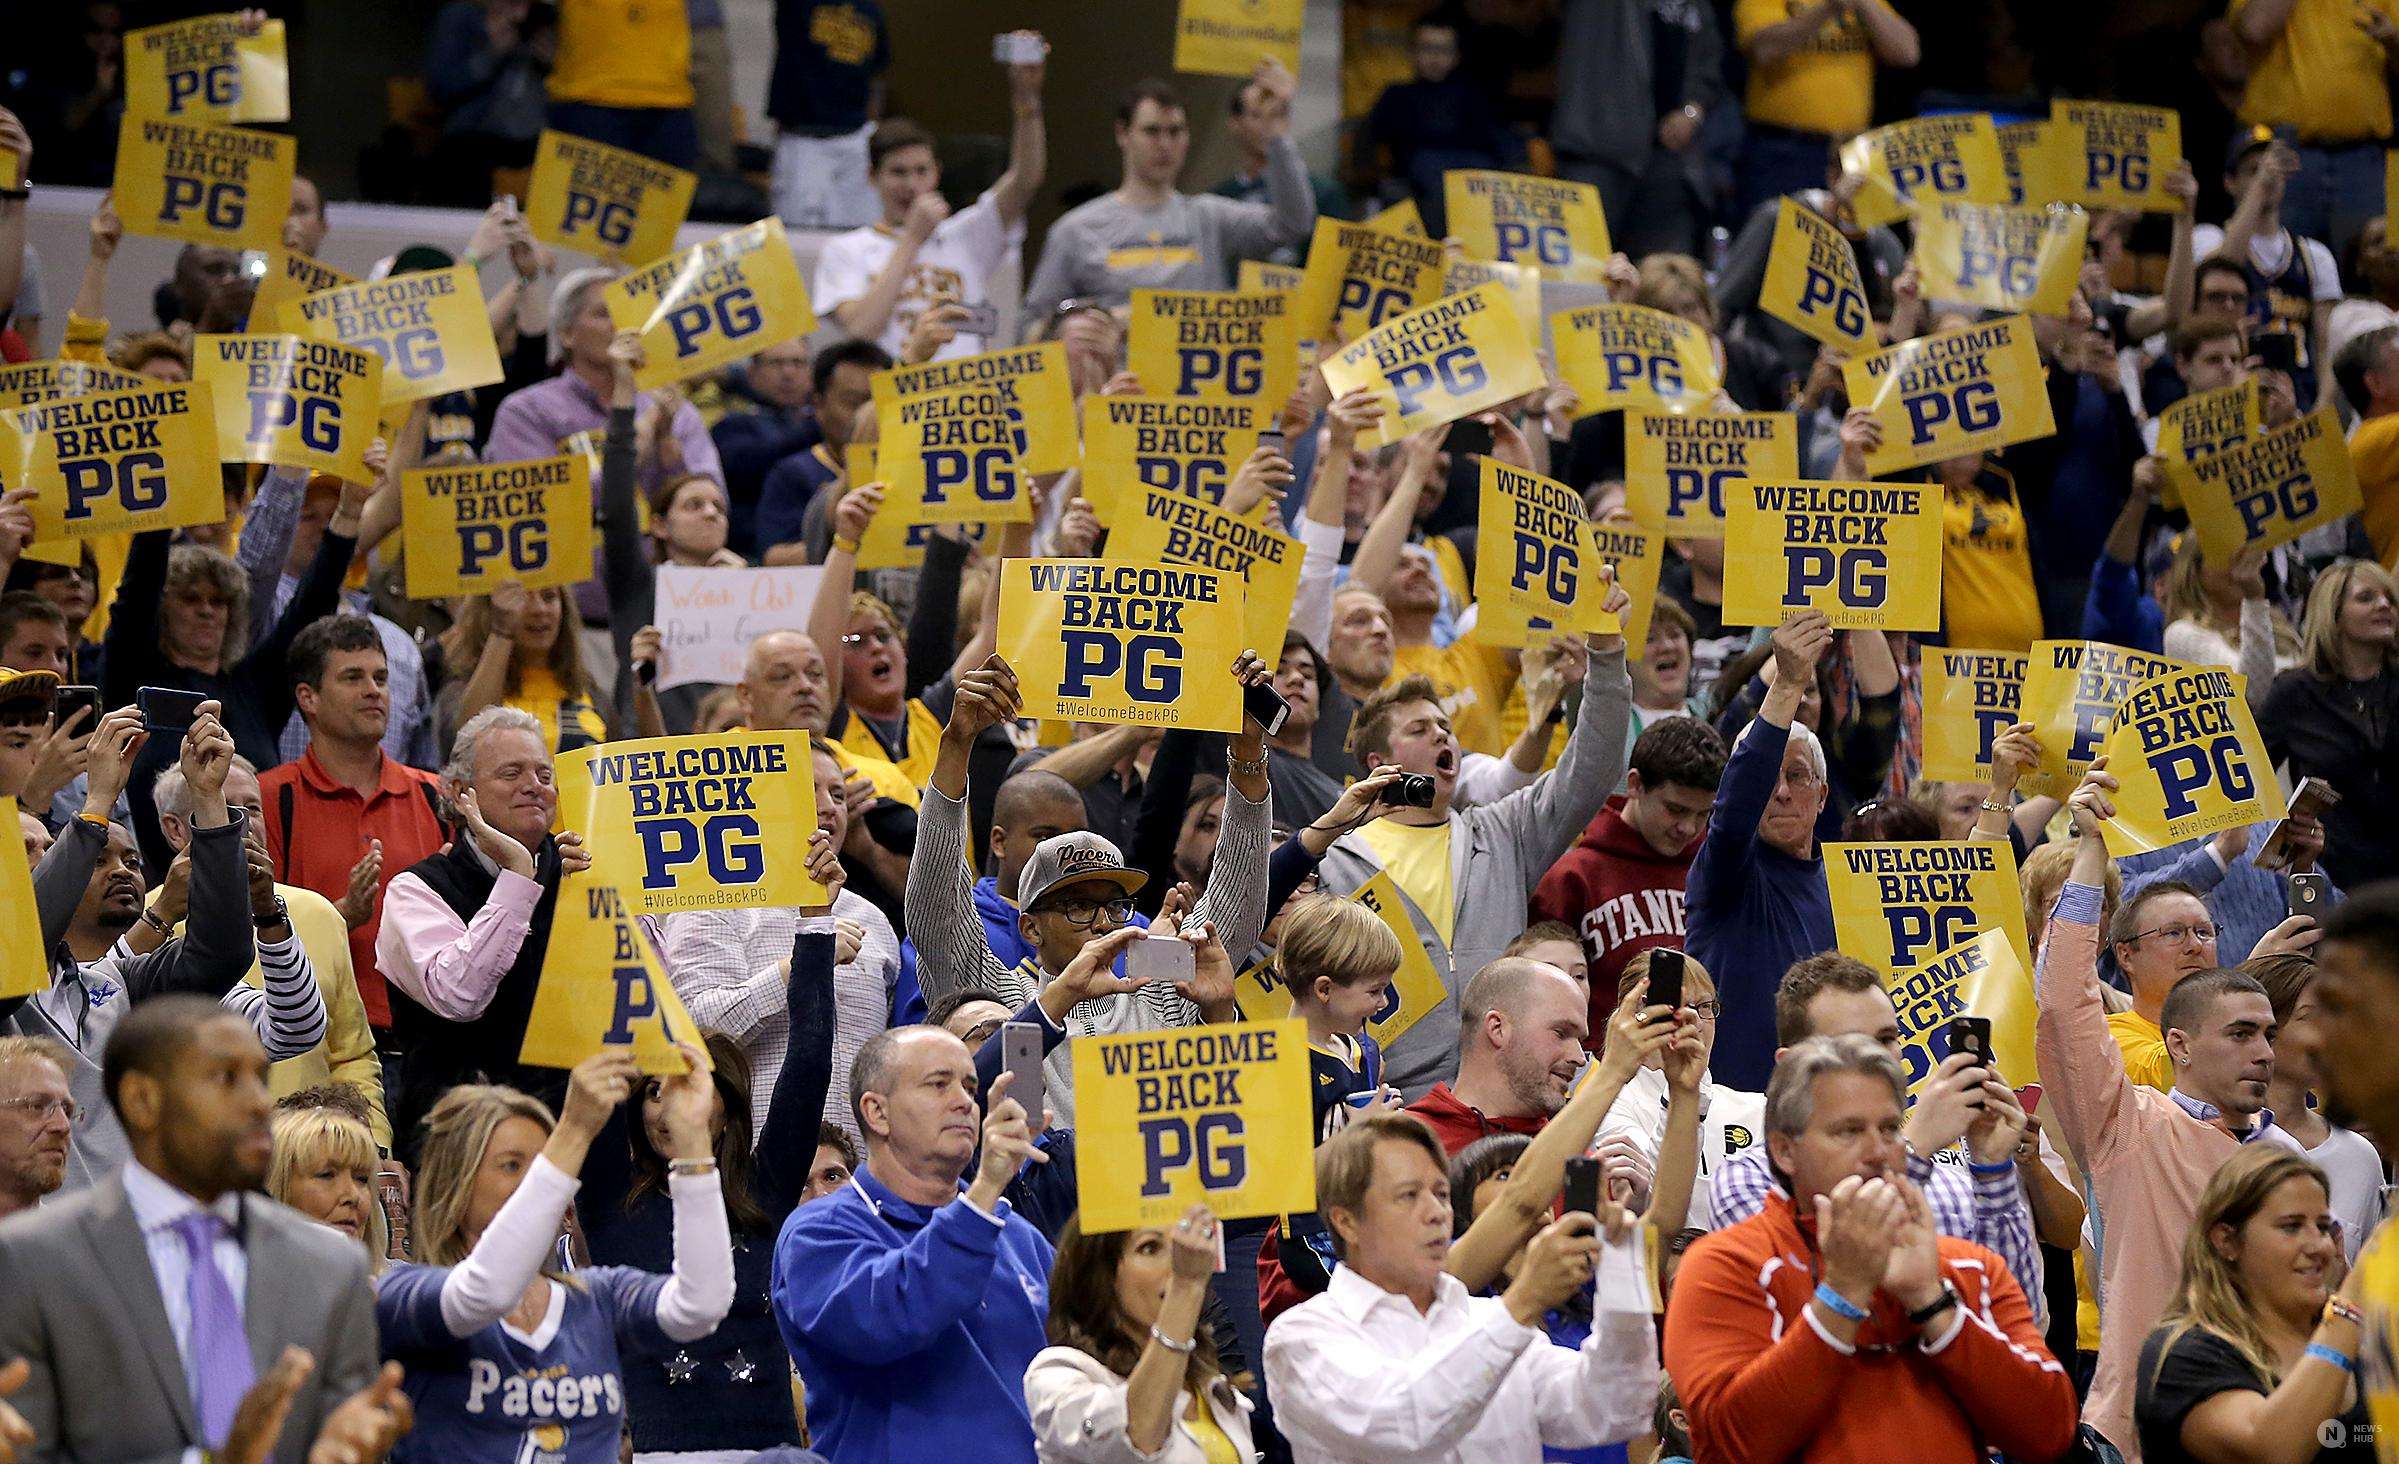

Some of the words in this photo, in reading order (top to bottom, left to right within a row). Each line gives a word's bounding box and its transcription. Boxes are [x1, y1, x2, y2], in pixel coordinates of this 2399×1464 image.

[167, 64, 241, 112] PG
[1891, 158, 1967, 198] PG
[2087, 151, 2149, 192] PG
[159, 175, 247, 229] PG
[561, 190, 638, 245] PG
[1495, 223, 1572, 265] PG
[1956, 250, 2037, 294] PG
[300, 273, 455, 321] WELCOME
[335, 300, 433, 339] BACK
[1154, 296, 1286, 318] WELCOME
[1798, 266, 1865, 337] PG
[665, 287, 763, 358] PG
[1178, 320, 1264, 344] BACK
[1342, 291, 1488, 366] WELCOME
[218, 338, 368, 378] WELCOME
[1373, 321, 1471, 371] BACK
[1866, 324, 2013, 377] WLCOME
[893, 351, 1044, 394] WELCOME
[1176, 348, 1264, 396] PG
[1384, 345, 1489, 417] PG
[1603, 352, 1684, 398] PG
[1900, 354, 1991, 393] BACK
[17, 389, 190, 434] WELCOME
[246, 391, 342, 454] PG
[902, 394, 1000, 424] WELCO
[1108, 403, 1253, 428] WELCOME
[1644, 416, 1774, 441] WELCOME
[1903, 381, 2001, 446] PG
[53, 420, 162, 459] BACK
[922, 419, 1010, 447] BACK
[1136, 427, 1229, 456] BACK
[1666, 442, 1747, 466] BACK
[58, 452, 168, 519] PG
[424, 461, 571, 497] WELCOME
[921, 449, 1016, 503] PG
[1496, 467, 1591, 522] WELCOM
[455, 488, 546, 521] BACK
[1515, 500, 1580, 547] BACK
[1753, 486, 1921, 515] WELCOME
[2234, 473, 2320, 543] PG
[456, 517, 549, 577] PG
[1145, 492, 1287, 565] WELCOME
[1783, 514, 1888, 545] BACK
[1164, 527, 1257, 582] BACK
[1511, 531, 1580, 606] PG
[1781, 546, 1888, 609] PG
[1029, 564, 1219, 604] WELCOME
[1061, 594, 1184, 634] BACK
[1057, 629, 1184, 704] PG
[1943, 655, 2030, 682] WELC
[2053, 647, 2183, 681] WELCO
[1973, 681, 2022, 709] BA
[2075, 674, 2140, 704] BA
[2112, 672, 2236, 736] WELCOME
[1056, 701, 1180, 724] #WelcomeBackPG
[2066, 704, 2116, 761] P
[2135, 701, 2235, 753] BACK
[1974, 710, 2020, 764] P
[586, 744, 788, 786] WELCOME
[2146, 735, 2256, 821] PG
[628, 776, 757, 818] BACK
[634, 813, 766, 890] PG
[1055, 842, 1121, 868] Pacers
[1844, 847, 1996, 874] WELCOME
[643, 887, 768, 908] #WelcomeBackPG
[1877, 873, 1974, 904] BACK
[1580, 888, 1687, 962] STANF
[1883, 905, 1980, 967] PG
[1888, 944, 1989, 1012] COME
[602, 966, 676, 1044] P
[1897, 983, 1969, 1042] ACK
[1101, 1031, 1278, 1076] WELCOME
[1136, 1069, 1243, 1114] BACK
[1138, 1112, 1246, 1197] PG
[465, 1358, 621, 1419] Pacers
